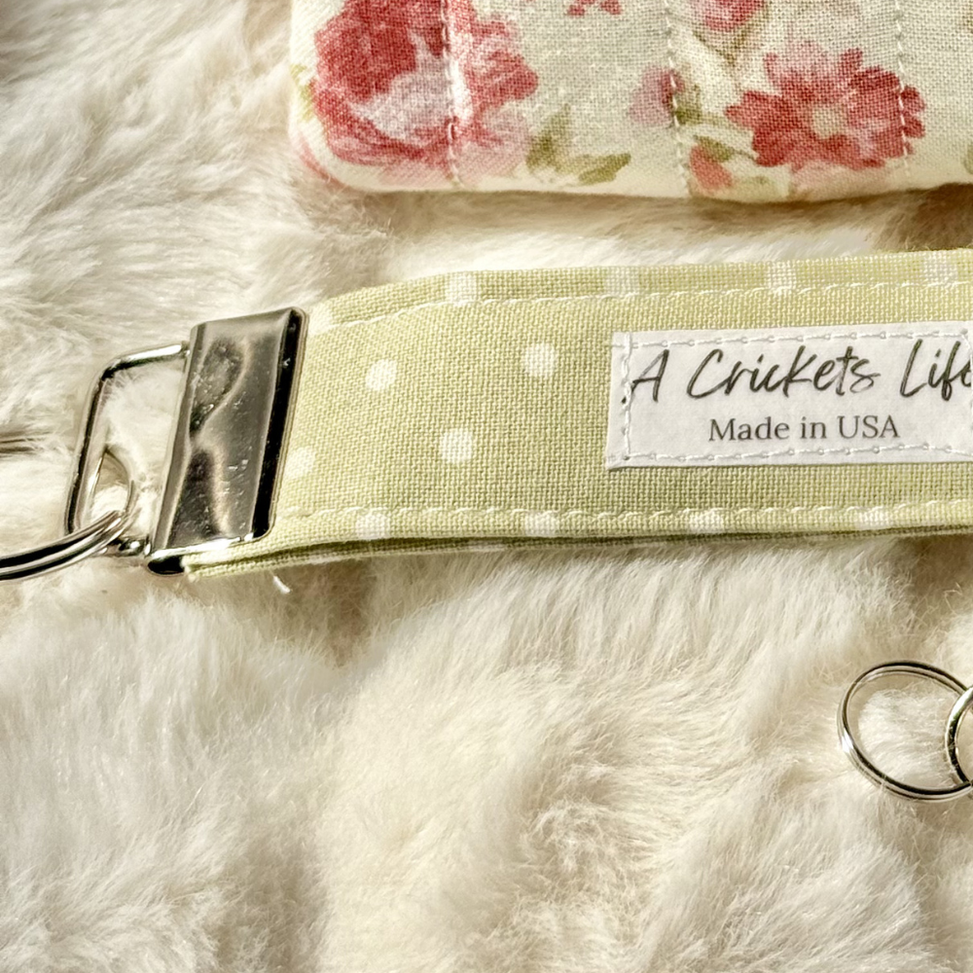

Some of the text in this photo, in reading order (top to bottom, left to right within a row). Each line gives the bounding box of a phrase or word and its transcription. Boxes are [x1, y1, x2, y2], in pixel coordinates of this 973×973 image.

[620, 349, 670, 404] A
[686, 344, 882, 398] Crickets
[708, 414, 901, 442] Made in USA
